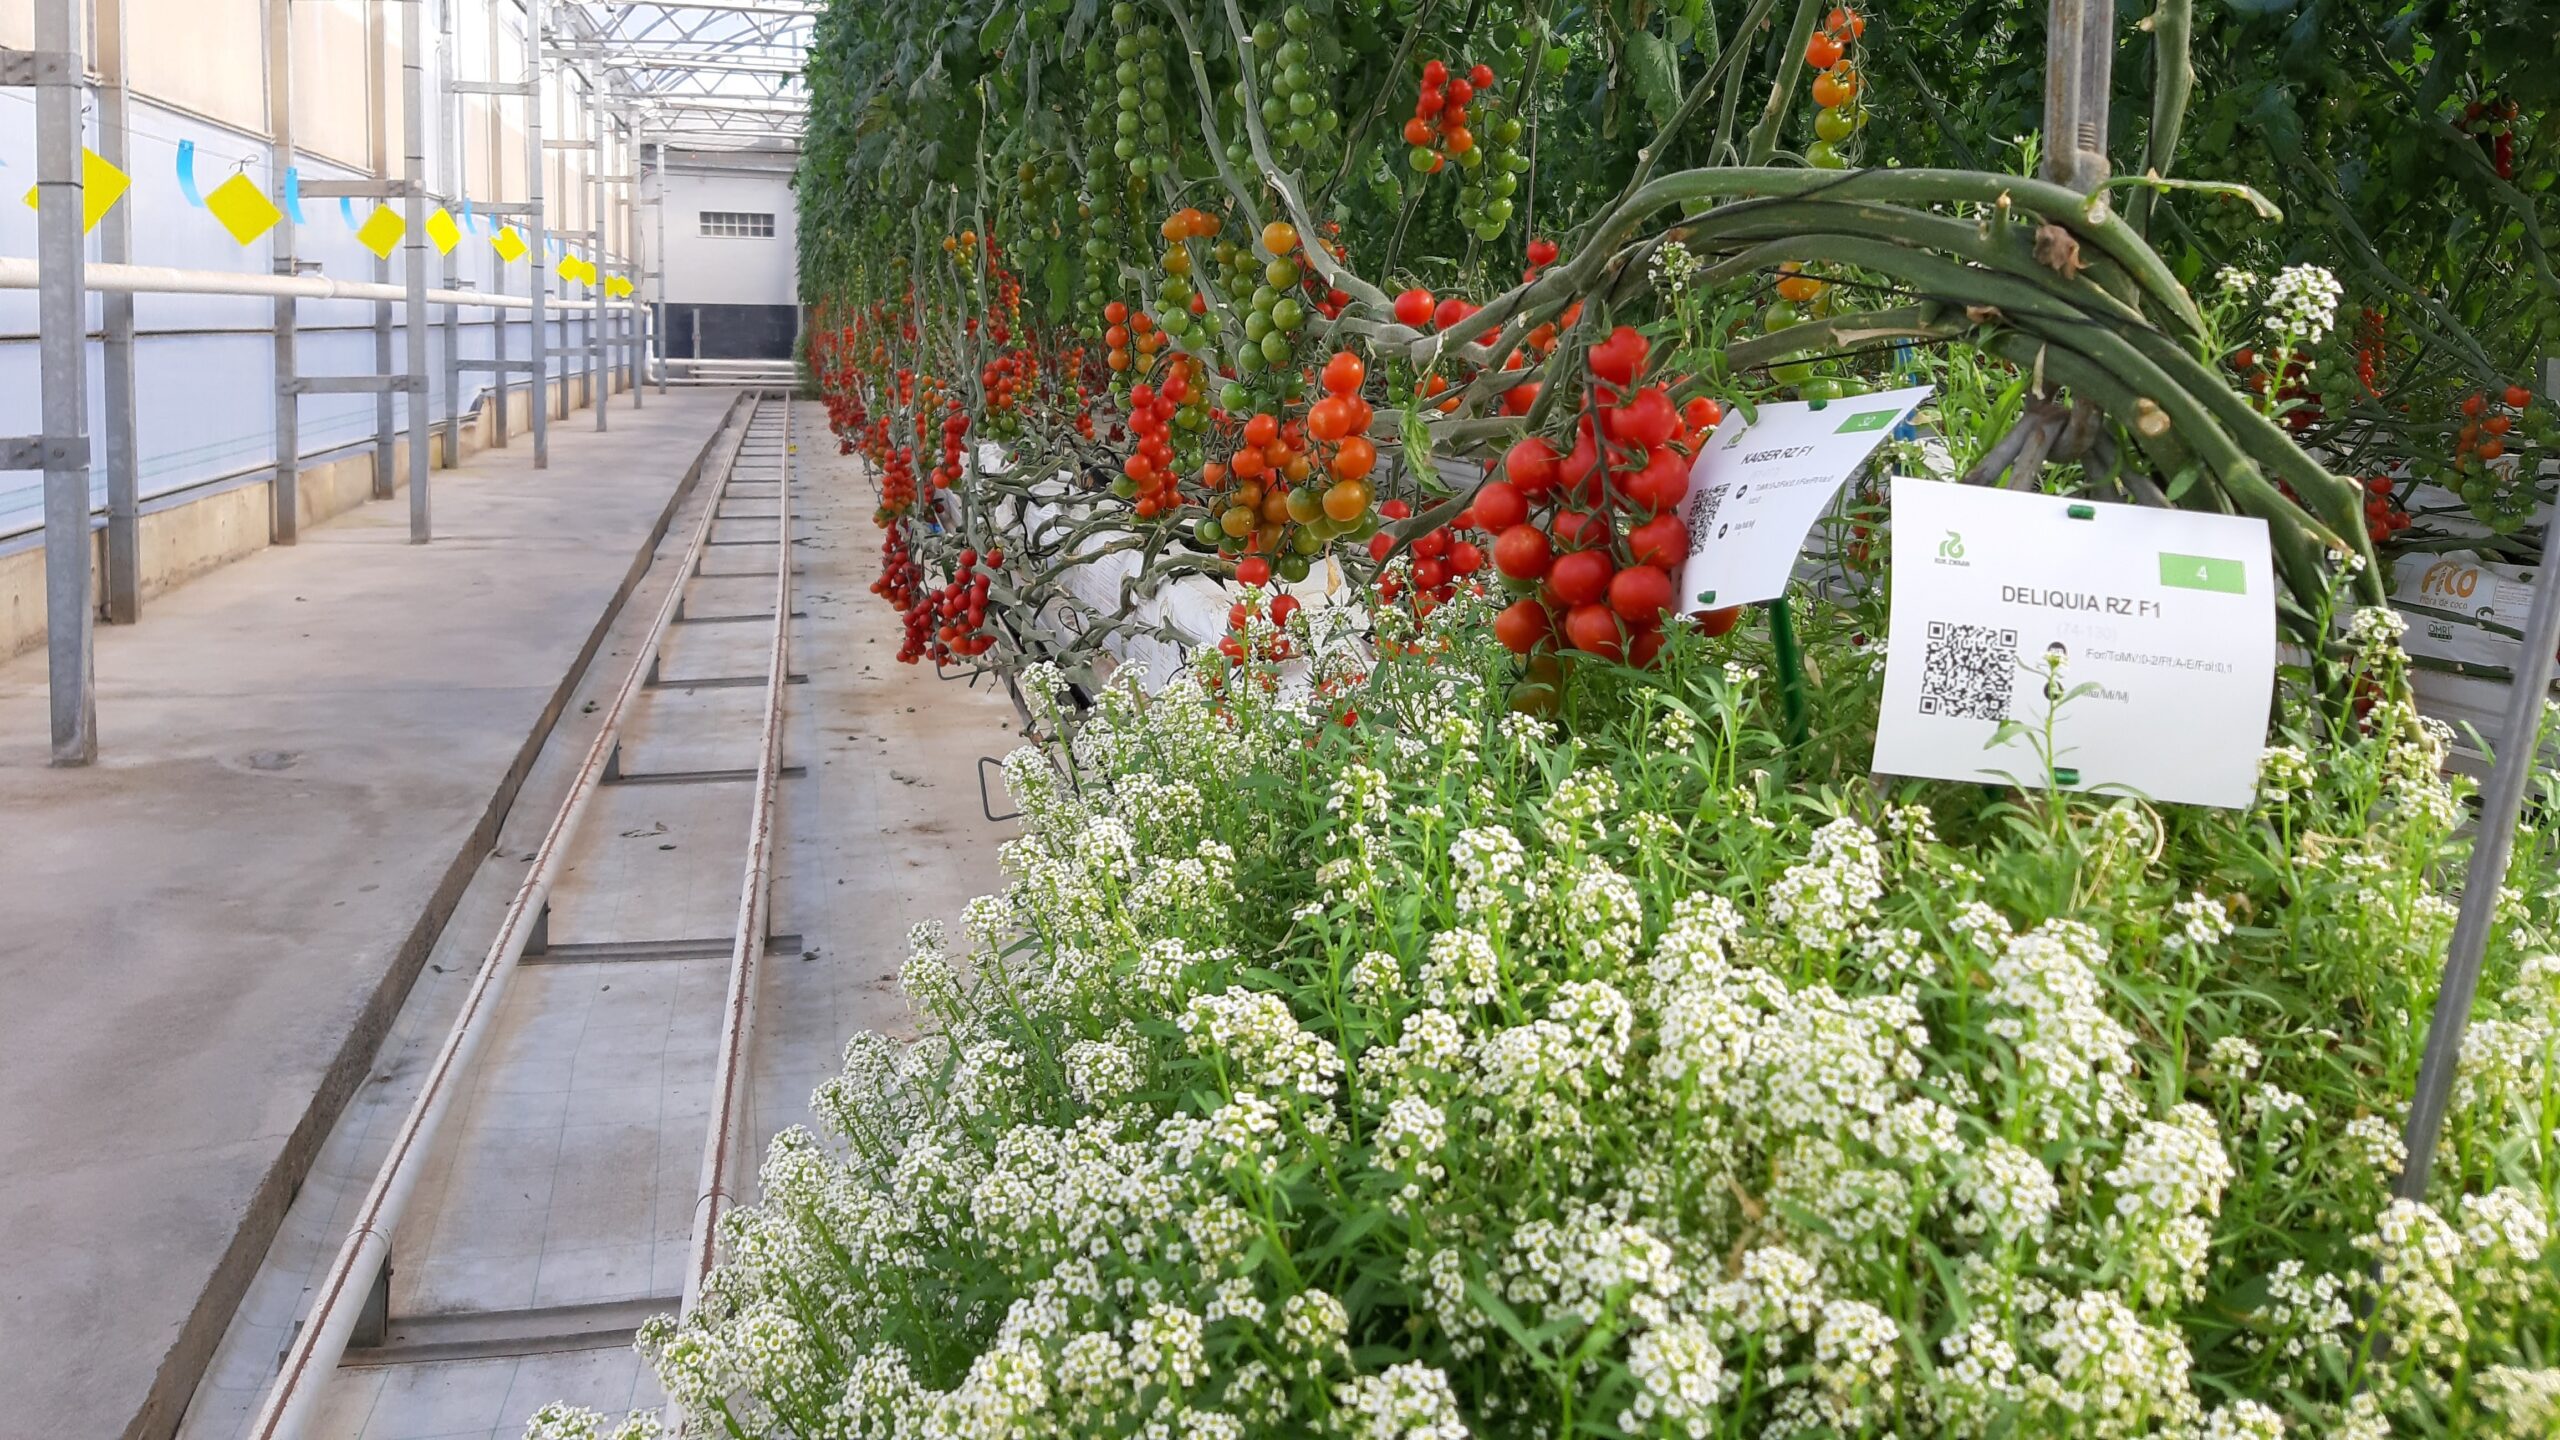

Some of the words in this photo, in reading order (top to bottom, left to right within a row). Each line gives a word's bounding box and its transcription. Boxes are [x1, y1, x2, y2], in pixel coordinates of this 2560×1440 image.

[1740, 448, 1783, 465] KAISER
[1780, 446, 1801, 459] RZ
[2196, 565, 2208, 581] 4
[2002, 585, 2100, 612] DELIQUIA
[2106, 596, 2132, 615] RZ
[2139, 600, 2160, 618] F1
